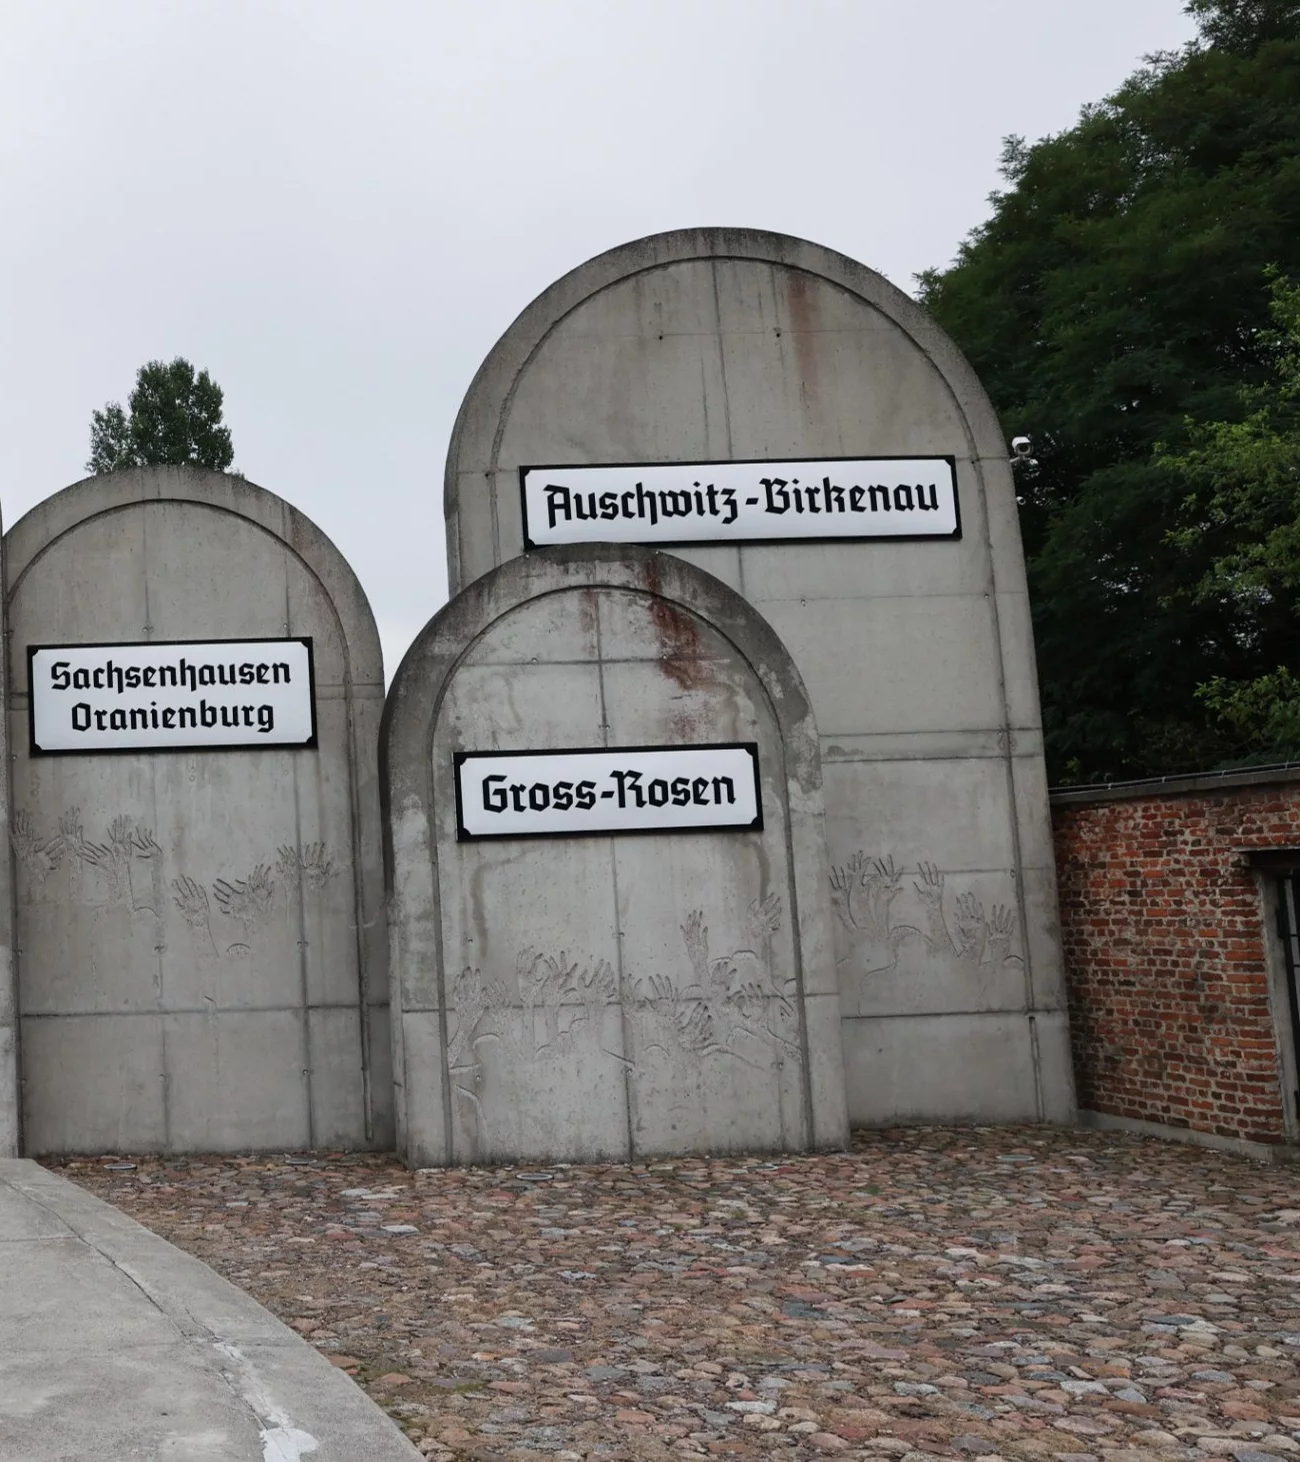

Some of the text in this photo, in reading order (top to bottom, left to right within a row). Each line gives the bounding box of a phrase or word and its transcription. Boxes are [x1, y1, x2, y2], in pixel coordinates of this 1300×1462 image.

[543, 476, 940, 529] Auschwitz-Birkenau
[50, 658, 292, 694] Sachsenhausen
[71, 698, 274, 734] Oranienburg
[481, 769, 736, 814] Gross-Rosen
